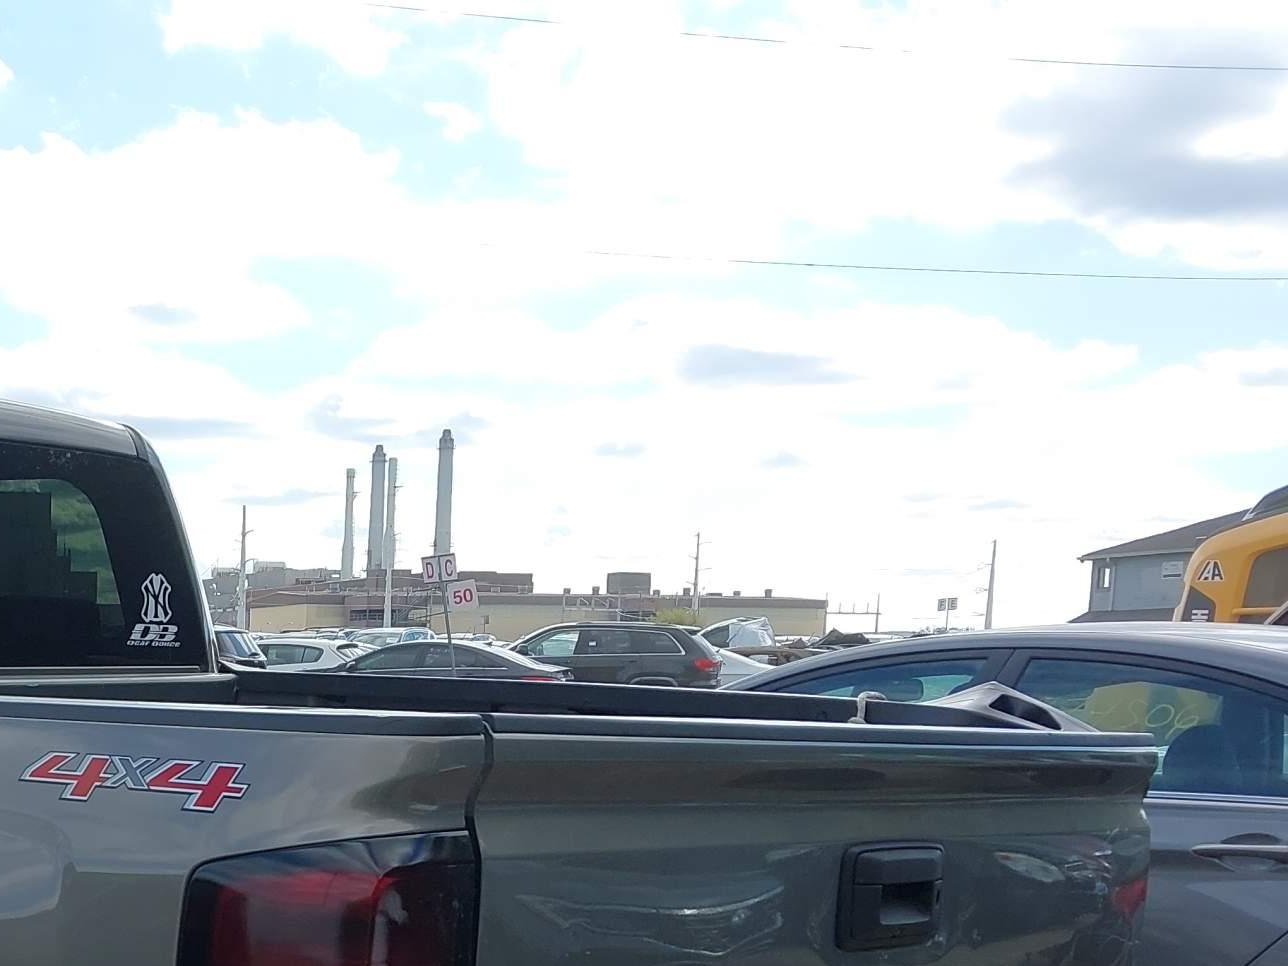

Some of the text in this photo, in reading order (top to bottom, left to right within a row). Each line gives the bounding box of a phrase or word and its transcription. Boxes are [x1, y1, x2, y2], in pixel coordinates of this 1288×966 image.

[425, 559, 453, 579] D C
[453, 588, 473, 605] 50
[129, 623, 178, 641] DB
